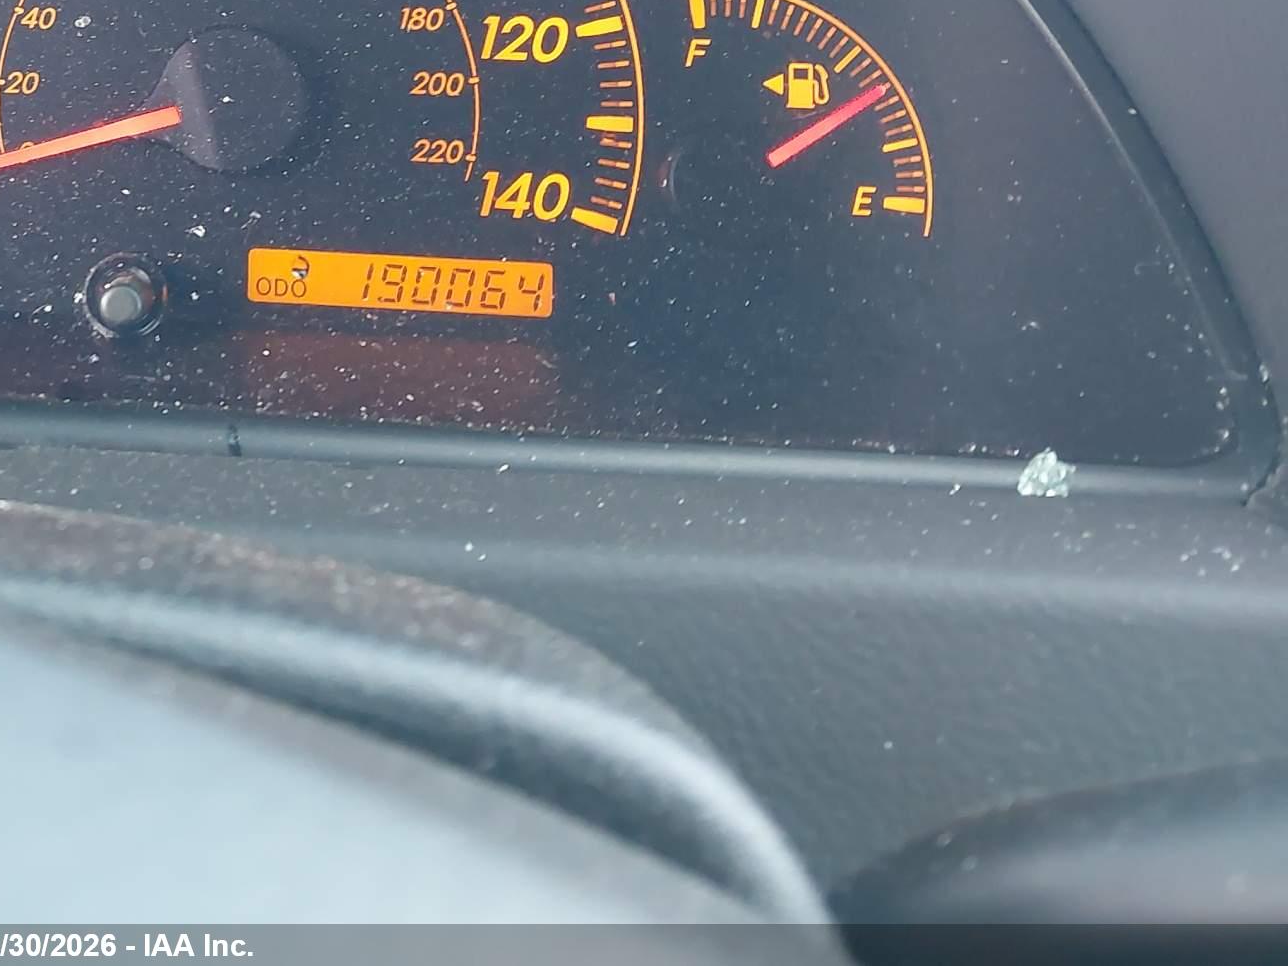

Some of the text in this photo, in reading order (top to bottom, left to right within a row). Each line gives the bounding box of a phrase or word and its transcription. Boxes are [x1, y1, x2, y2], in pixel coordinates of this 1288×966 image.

[21, 6, 56, 30] 40
[400, 7, 444, 32] 180
[480, 15, 569, 64] 120
[684, 38, 711, 68] F
[5, 71, 40, 95] 20
[410, 72, 464, 96] 200
[410, 138, 463, 164] 220
[479, 171, 570, 220] 140
[851, 185, 877, 217] E
[256, 262, 545, 312] ODO 190064
